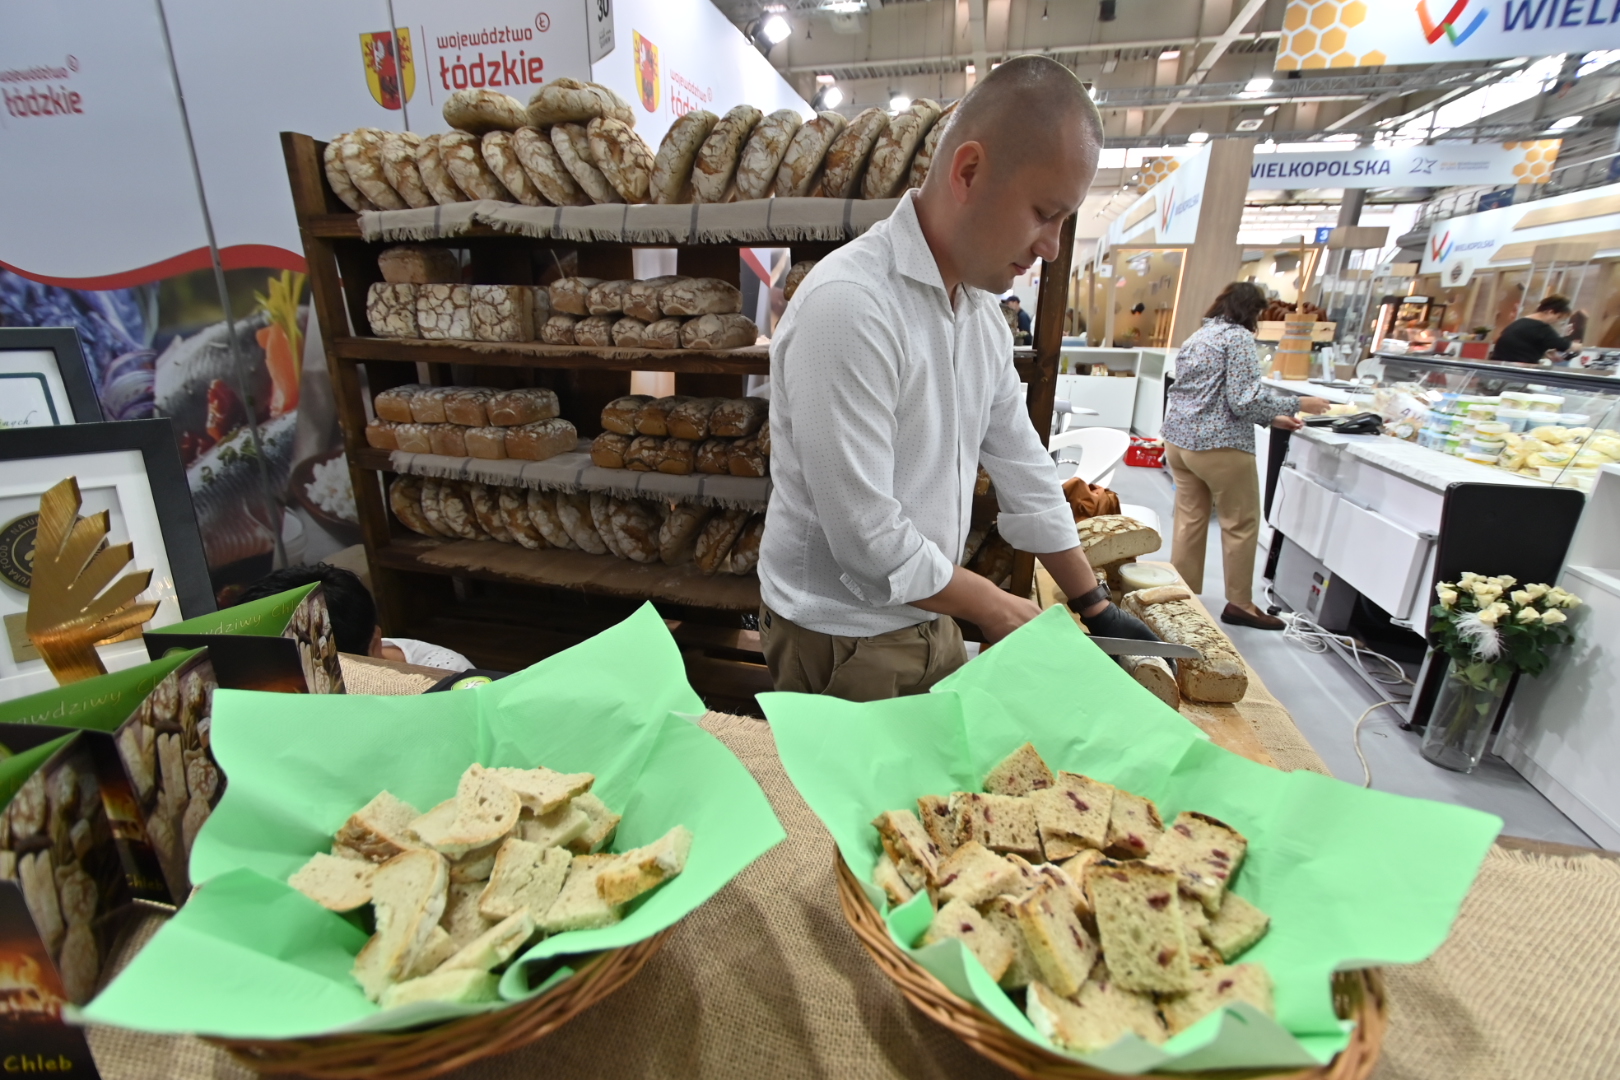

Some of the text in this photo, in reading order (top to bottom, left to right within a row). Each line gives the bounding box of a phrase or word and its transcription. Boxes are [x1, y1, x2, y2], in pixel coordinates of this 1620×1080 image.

[436, 25, 533, 51] województwo
[439, 50, 544, 90] łódzkie
[3, 1053, 73, 1073] Chleb
